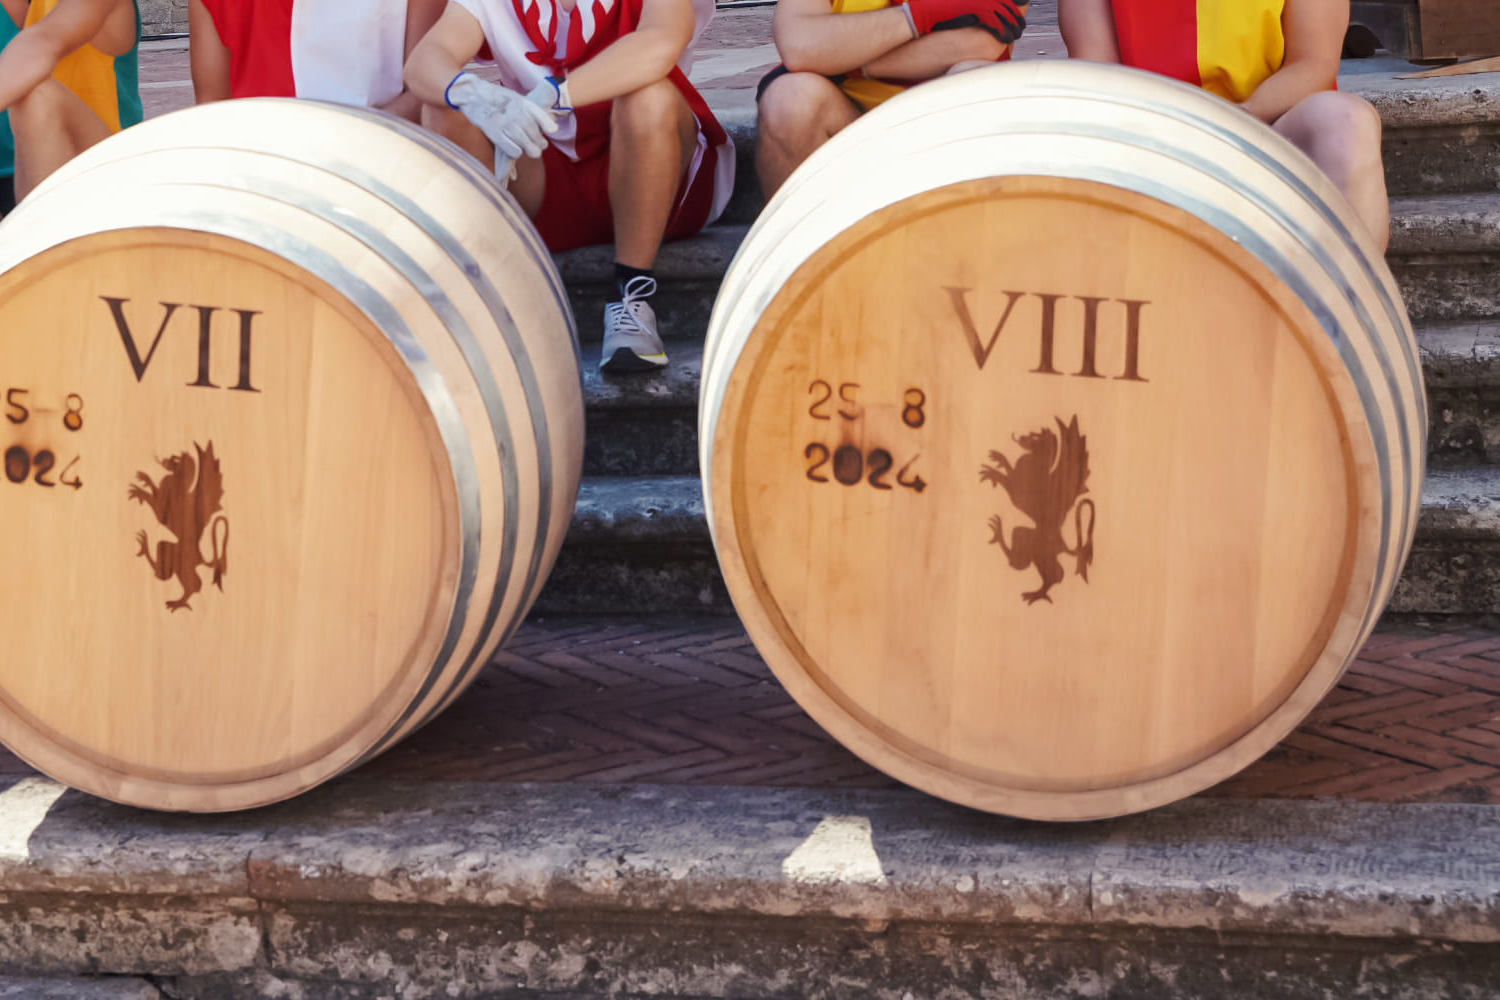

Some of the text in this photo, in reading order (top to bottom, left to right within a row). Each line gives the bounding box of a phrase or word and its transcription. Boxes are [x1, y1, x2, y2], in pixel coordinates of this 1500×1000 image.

[98, 295, 263, 393] VII
[939, 286, 1152, 383] VIII
[804, 442, 928, 493] 2024
